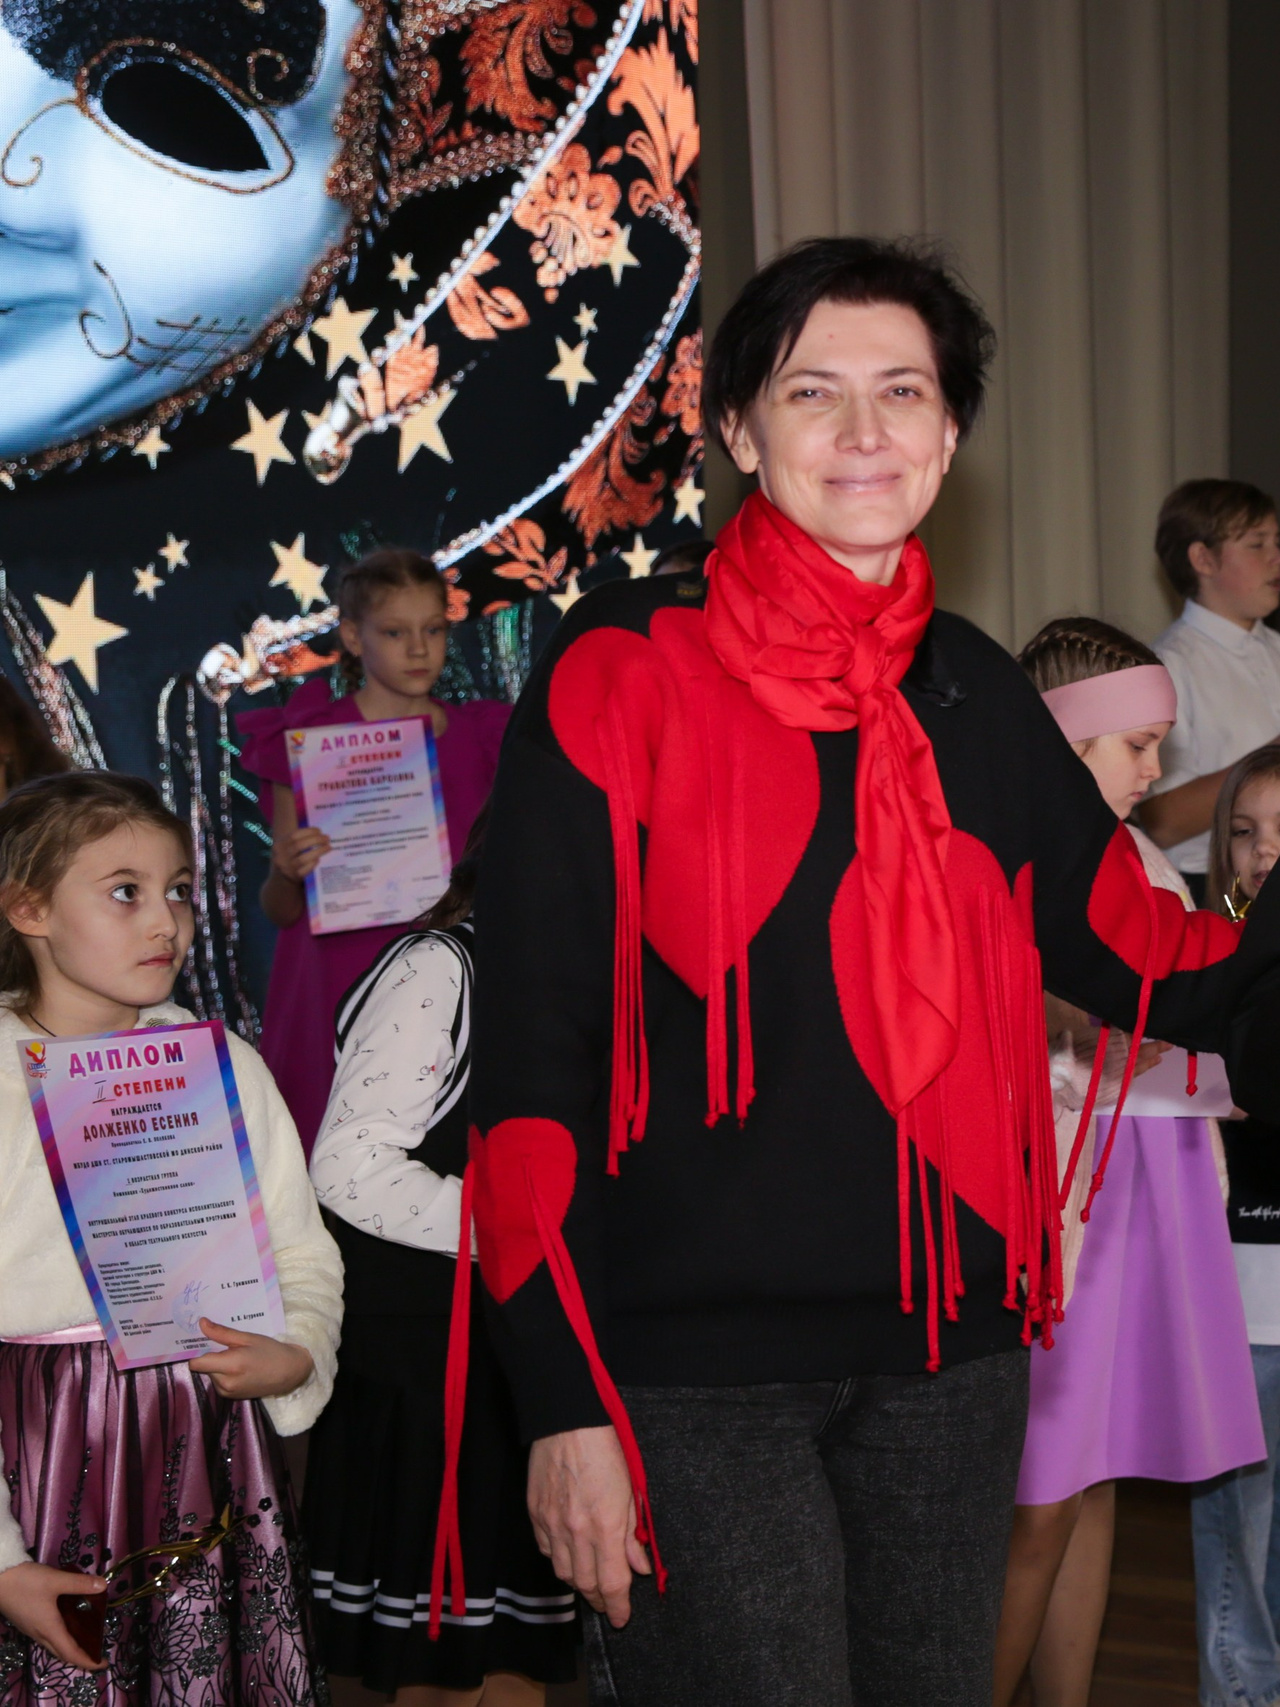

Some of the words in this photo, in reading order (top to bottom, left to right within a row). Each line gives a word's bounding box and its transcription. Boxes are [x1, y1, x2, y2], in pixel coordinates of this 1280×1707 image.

[69, 1041, 184, 1078] ДИПЛОМ
[113, 1076, 186, 1097] СТЕПЕНИ
[110, 1102, 162, 1116] НАГРАЖДАЕТСЯ
[83, 1118, 147, 1142] ДОЛЖЕНКО
[151, 1111, 199, 1131] ЕСЕНИЯ
